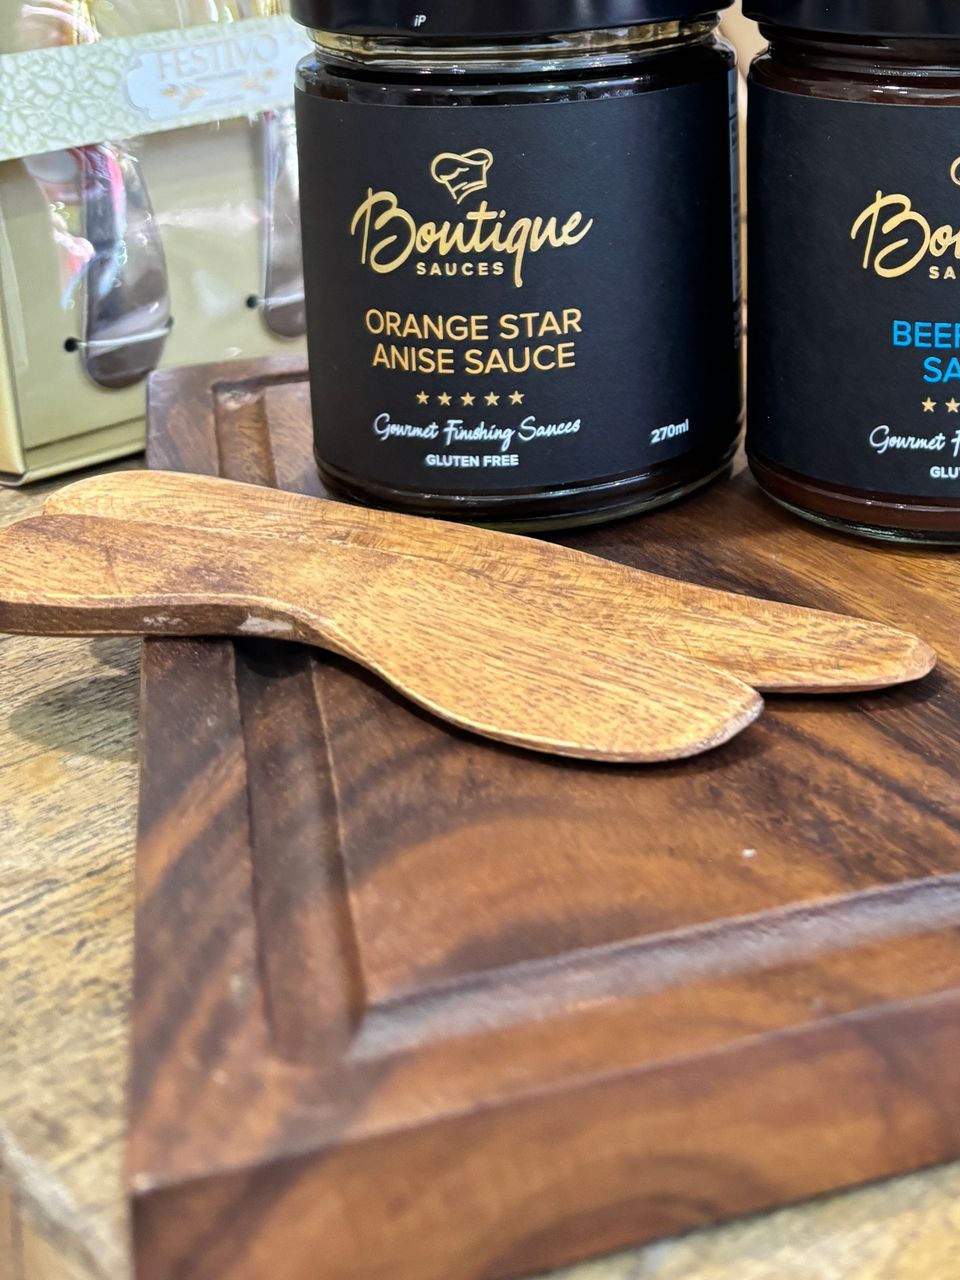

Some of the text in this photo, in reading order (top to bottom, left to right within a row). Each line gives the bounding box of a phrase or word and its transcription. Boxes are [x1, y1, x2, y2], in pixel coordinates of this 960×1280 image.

[157, 32, 278, 82] FESTIVO
[351, 187, 593, 287] Boutique
[417, 262, 503, 275] SAUCES
[366, 309, 581, 340] ORANGE STAR
[373, 342, 575, 374] ANISE SAUCE
[374, 413, 580, 452] Gourmet Finishing Sauces
[651, 419, 688, 443] 270ml
[869, 425, 945, 452] Gourmet
[426, 454, 519, 467] GLUTEN FREE
